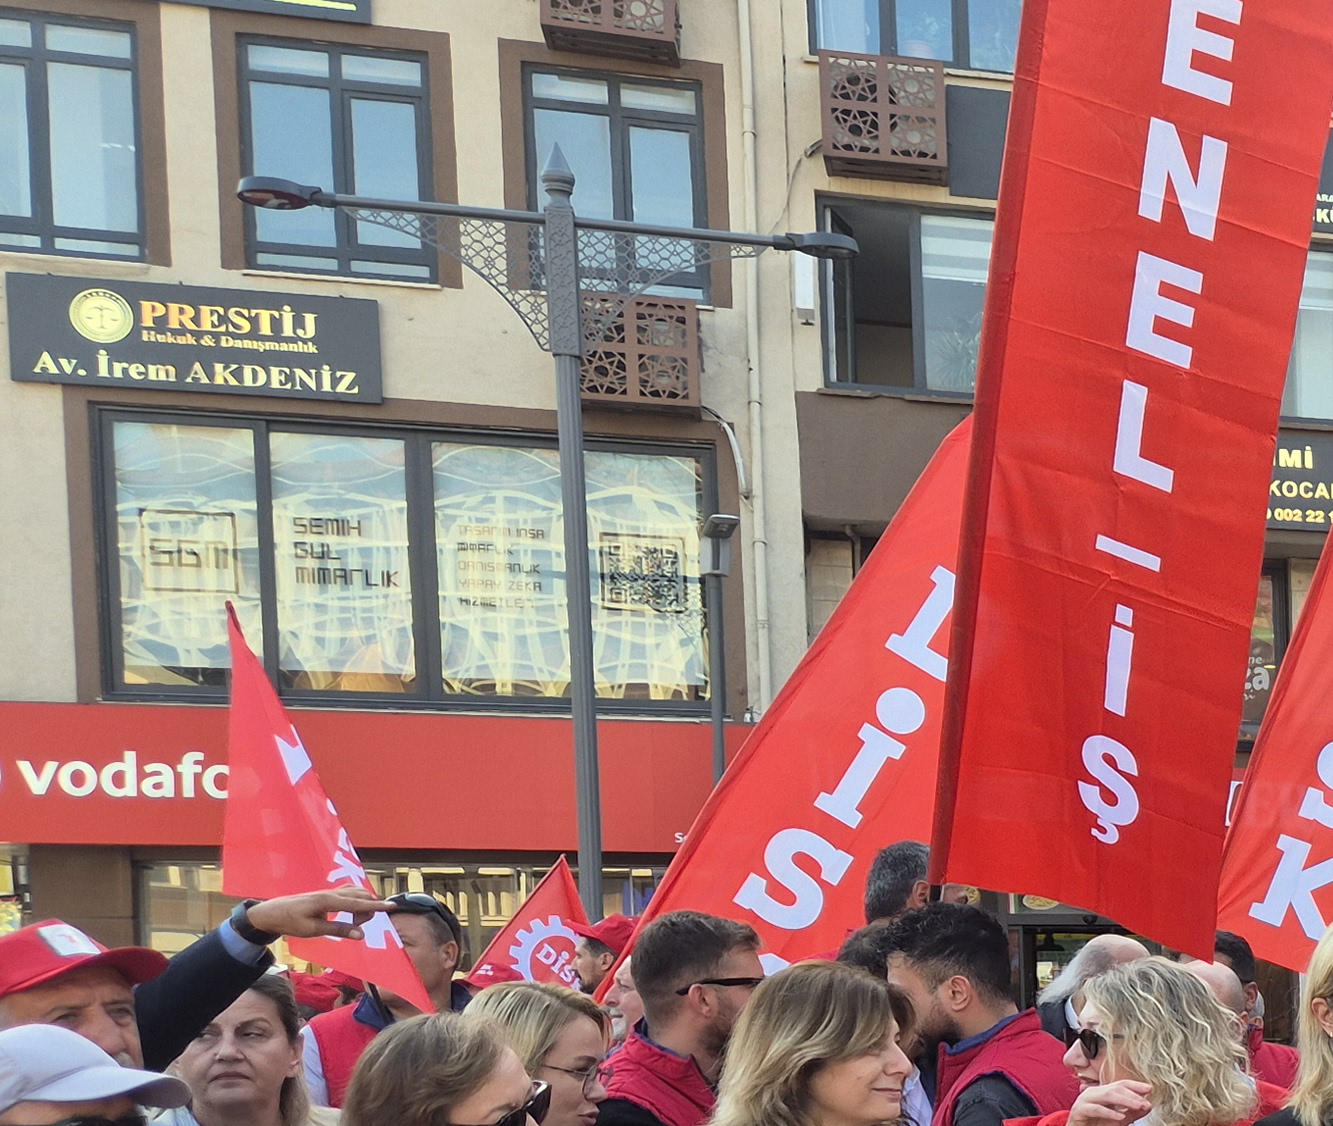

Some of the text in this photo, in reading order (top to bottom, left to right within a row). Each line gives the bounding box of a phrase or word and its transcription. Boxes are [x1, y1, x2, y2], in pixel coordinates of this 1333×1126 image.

[139, 300, 318, 339] PRESTİJ
[141, 330, 319, 354] Hukuk & Danışmanlık
[33, 350, 359, 395] Av. İrem AKDENİZ
[1273, 446, 1314, 469] Mİ
[1305, 509, 1325, 523] 22
[15, 750, 229, 799] vodafo
